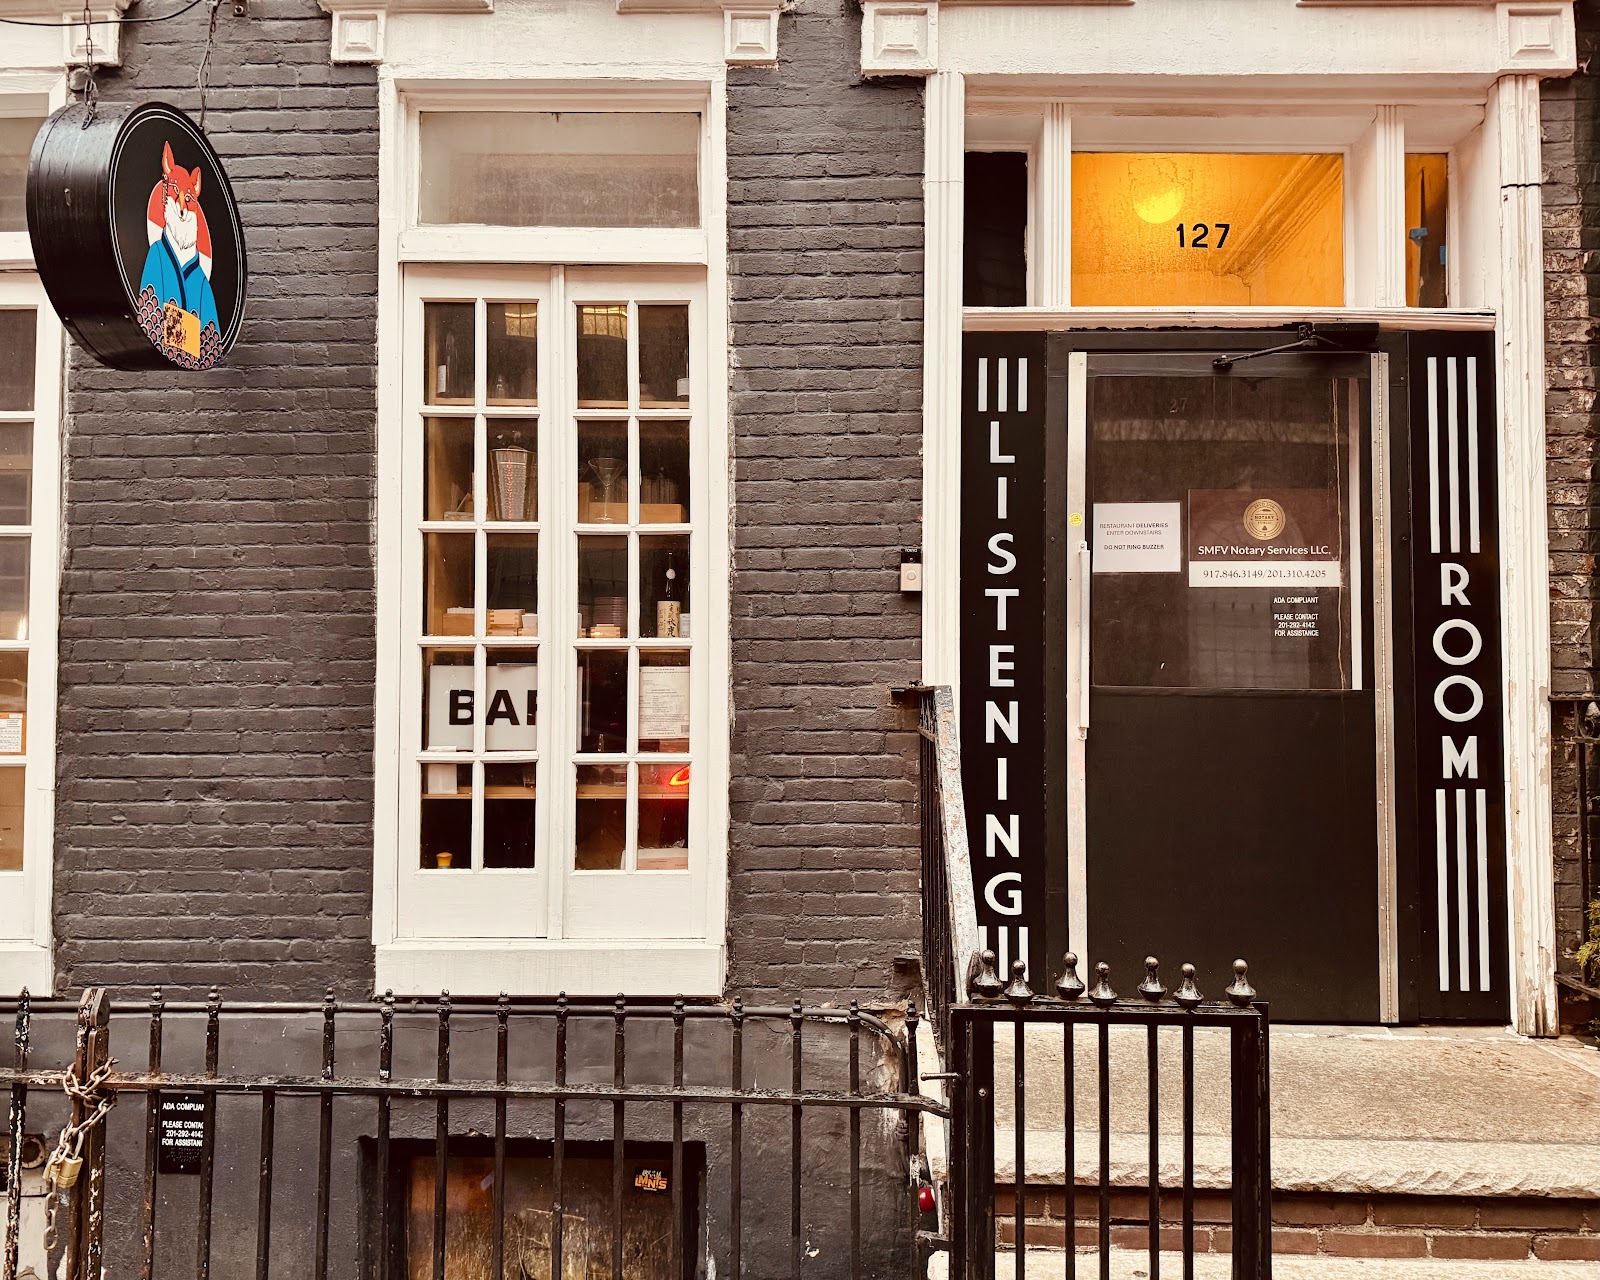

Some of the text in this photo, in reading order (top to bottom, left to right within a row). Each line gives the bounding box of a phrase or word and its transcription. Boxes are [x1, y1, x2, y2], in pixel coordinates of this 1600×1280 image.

[1176, 223, 1230, 248] 127
[1198, 545, 1331, 557] SMFV Notary Services LLC.
[1203, 569, 1327, 579] 917.846.3149/201.310.4205
[1273, 596, 1319, 604] ADA COMPLIANT
[1278, 621, 1316, 629] 201-292-4142
[1274, 629, 1320, 637] FOR ASSISTANCE
[984, 421, 1023, 916] LISTENING
[1432, 562, 1484, 779] ROOM
[162, 1102, 175, 1110] ADA
[162, 1120, 183, 1129] PLEASE
[161, 1138, 174, 1146] FOR
